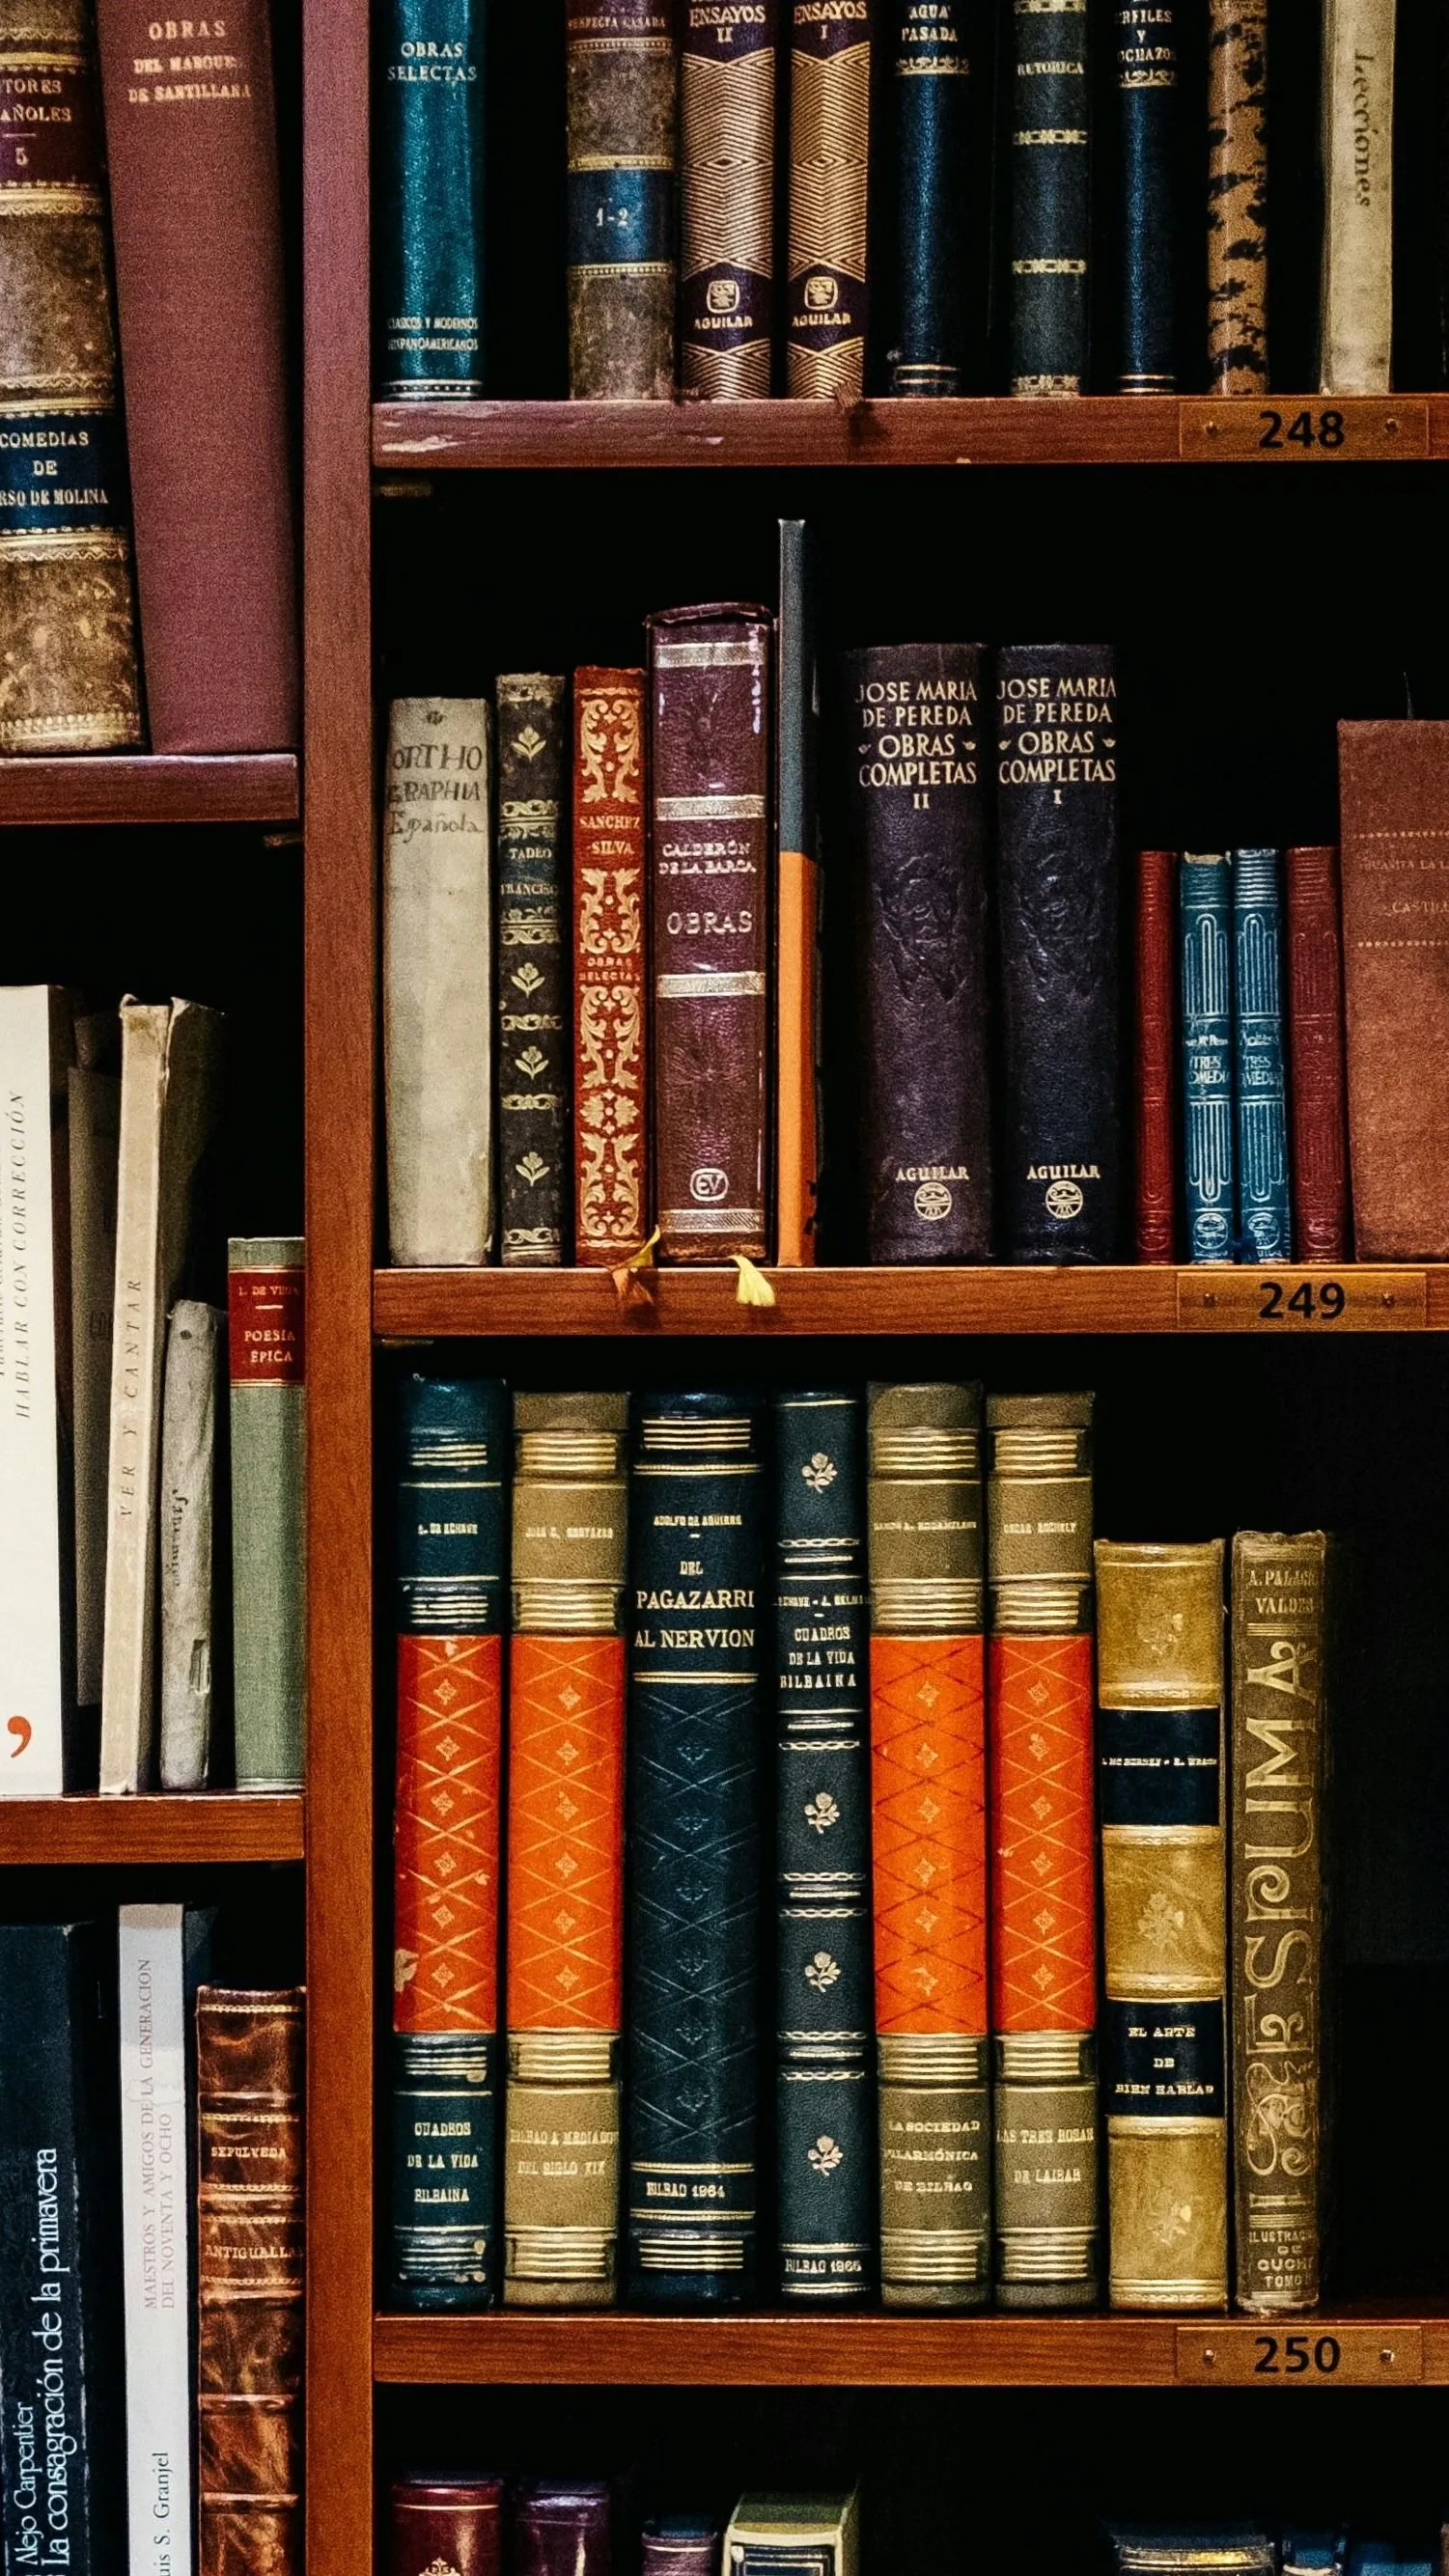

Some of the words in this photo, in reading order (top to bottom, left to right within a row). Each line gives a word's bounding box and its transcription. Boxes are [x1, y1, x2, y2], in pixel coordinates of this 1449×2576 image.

[690, 6, 766, 26] ENSAYOS
[794, 1, 867, 24] ENSAYOS
[149, 20, 226, 39] OBRAS
[717, 27, 733, 42] II
[401, 42, 463, 58] OBRAS
[386, 66, 478, 82] SELECTAS
[694, 314, 753, 329] AGUILAR
[792, 312, 851, 328] AGUILAR
[0, 431, 90, 448] COMEDIAS
[1258, 410, 1345, 449] 248
[33, 459, 58, 476] DE
[53, 488, 109, 505] MOLINA
[855, 681, 911, 703] JOSE
[916, 679, 978, 702] MARIA
[996, 677, 1050, 700] JOSE
[1056, 676, 1118, 698] MARIA
[862, 706, 886, 729] DE
[895, 705, 972, 727] PEREDA
[1003, 704, 1026, 725] DE
[1034, 703, 1113, 724] PEREDA
[878, 733, 956, 759] OBRAS
[1017, 730, 1095, 756] OBRAS
[858, 761, 978, 788] COMPLETAS
[998, 758, 1117, 785] COMPLETAS
[913, 792, 931, 810] II
[1053, 789, 1063, 805] I
[579, 814, 641, 831] SANCHEZ
[666, 910, 753, 935] OBRAS
[8, 1092, 27, 1252] CORRECCIÓN
[896, 1165, 970, 1182] AGUILAR
[1026, 1164, 1101, 1181] AGUILAR
[14, 1260, 28, 1308] CON
[1259, 1282, 1345, 1319] 249
[125, 1280, 142, 1399] CANTAR
[14, 1319, 31, 1420] HABLAR
[123, 1426, 137, 1438] Y
[120, 1465, 136, 1517] VER
[636, 1591, 755, 1610] PAGAZARRI
[634, 1630, 655, 1648] AL
[660, 1629, 755, 1648] NERVION
[794, 1626, 850, 1642] CUADROS
[789, 1651, 804, 1666] DE
[806, 1651, 822, 1666] LA
[827, 1651, 856, 1666] VIDA
[780, 1675, 857, 1689] BILBAINA
[138, 1958, 153, 2068] GENERACION
[1128, 2027, 1148, 2037] EL
[1153, 2027, 1196, 2037] ARTE
[1153, 2057, 1175, 2068] DE
[140, 2076, 153, 2096] LA
[1114, 2084, 1151, 2095] BIEN
[414, 2122, 472, 2137] CUADROS
[906, 2120, 981, 2133] SOCIEDAD
[159, 2113, 173, 2164] OCHO
[210, 2146, 287, 2159] SEPULVEDA
[406, 2154, 422, 2169] DE
[428, 2154, 445, 2169] LA
[451, 2154, 479, 2169] VIDA
[141, 2131, 155, 2198] AMIGOS
[159, 2171, 173, 2183] Y
[414, 2188, 470, 2202] BILBAINA
[646, 2181, 687, 2197] BILBAO
[31, 2147, 70, 2273] primavera
[142, 2205, 154, 2217] Y
[159, 2190, 175, 2271] NOVENTA
[142, 2223, 158, 2310] MAESTROS
[784, 2257, 826, 2275] BILBAO
[31, 2282, 62, 2302] la
[160, 2277, 175, 2310] DEL
[32, 2311, 62, 2352] de
[1254, 2336, 1341, 2374] 250
[12, 2401, 43, 2509] Carpentier
[37, 2359, 77, 2531] consagración
[152, 2451, 174, 2519] Granjel
[14, 2515, 44, 2565] Alejo
[153, 2529, 171, 2546] S.
[42, 2536, 70, 2566] La
